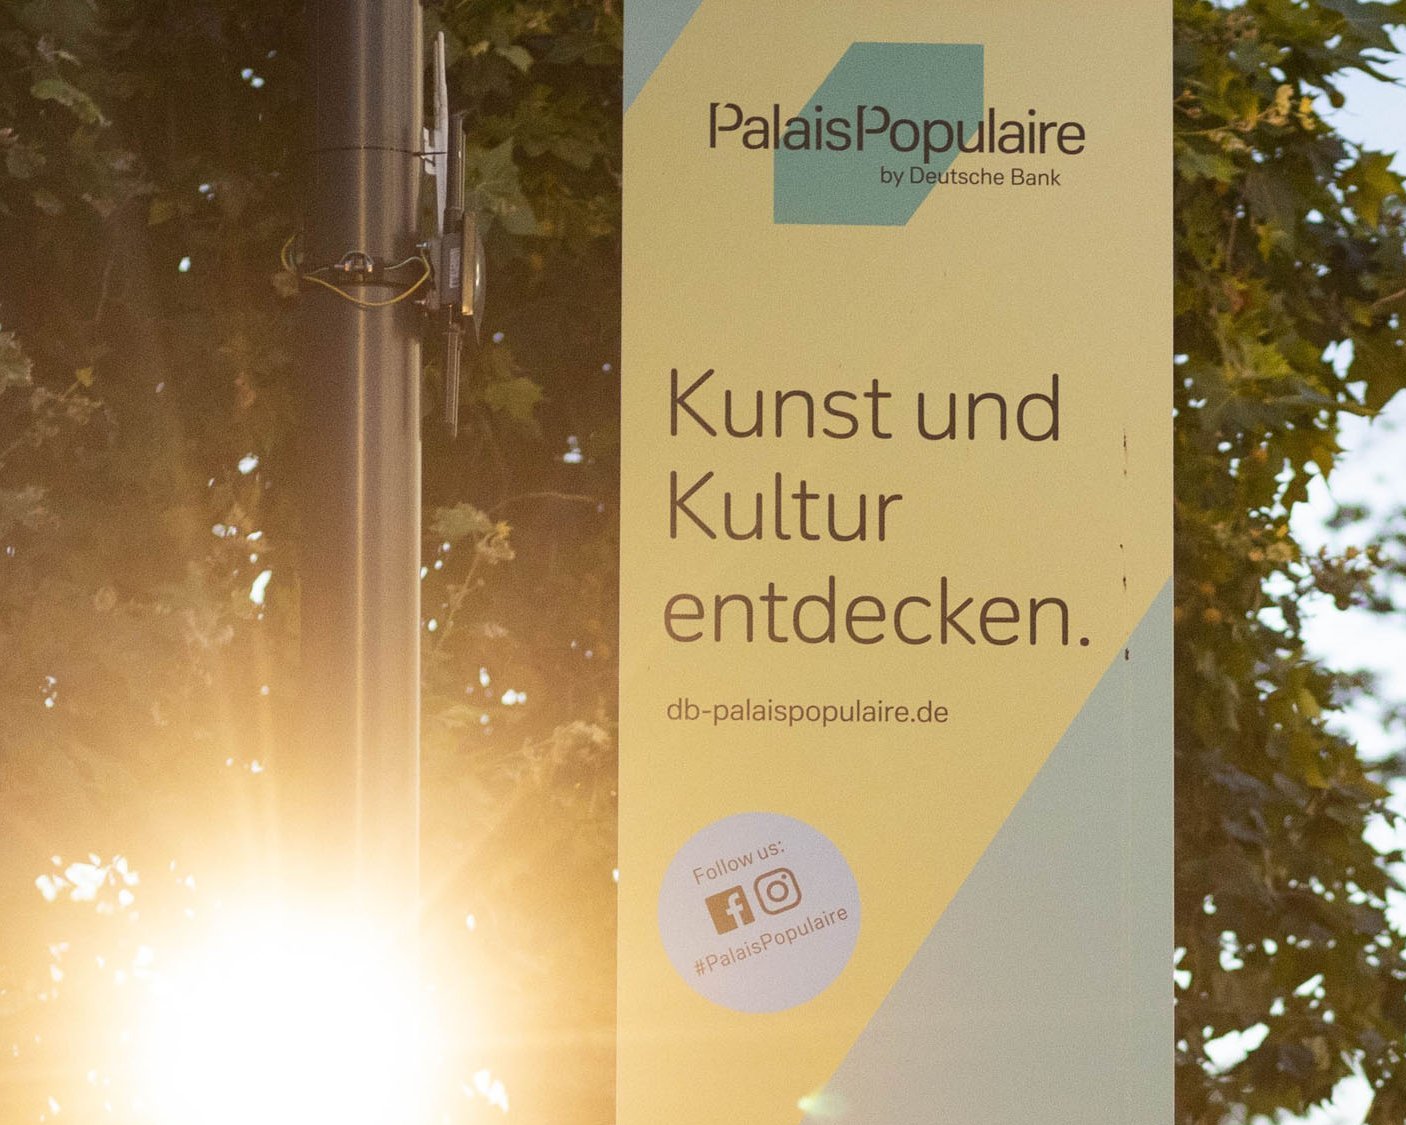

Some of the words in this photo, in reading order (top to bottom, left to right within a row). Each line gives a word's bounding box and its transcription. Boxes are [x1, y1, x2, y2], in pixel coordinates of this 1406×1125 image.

[709, 102, 1085, 164] PalaisPopulaire
[880, 166, 904, 188] by
[909, 166, 1005, 186] Deutsche
[1010, 167, 1061, 187] Bank
[670, 368, 893, 439] Kunst
[917, 373, 1060, 441] und
[669, 470, 903, 541] Kultur
[664, 574, 1090, 646] entdecken.
[666, 697, 949, 728] db-palaispopulaire.de
[693, 853, 753, 885] Follow
[758, 840, 785, 860] us:
[694, 907, 848, 976] #PalaisPopulaire
